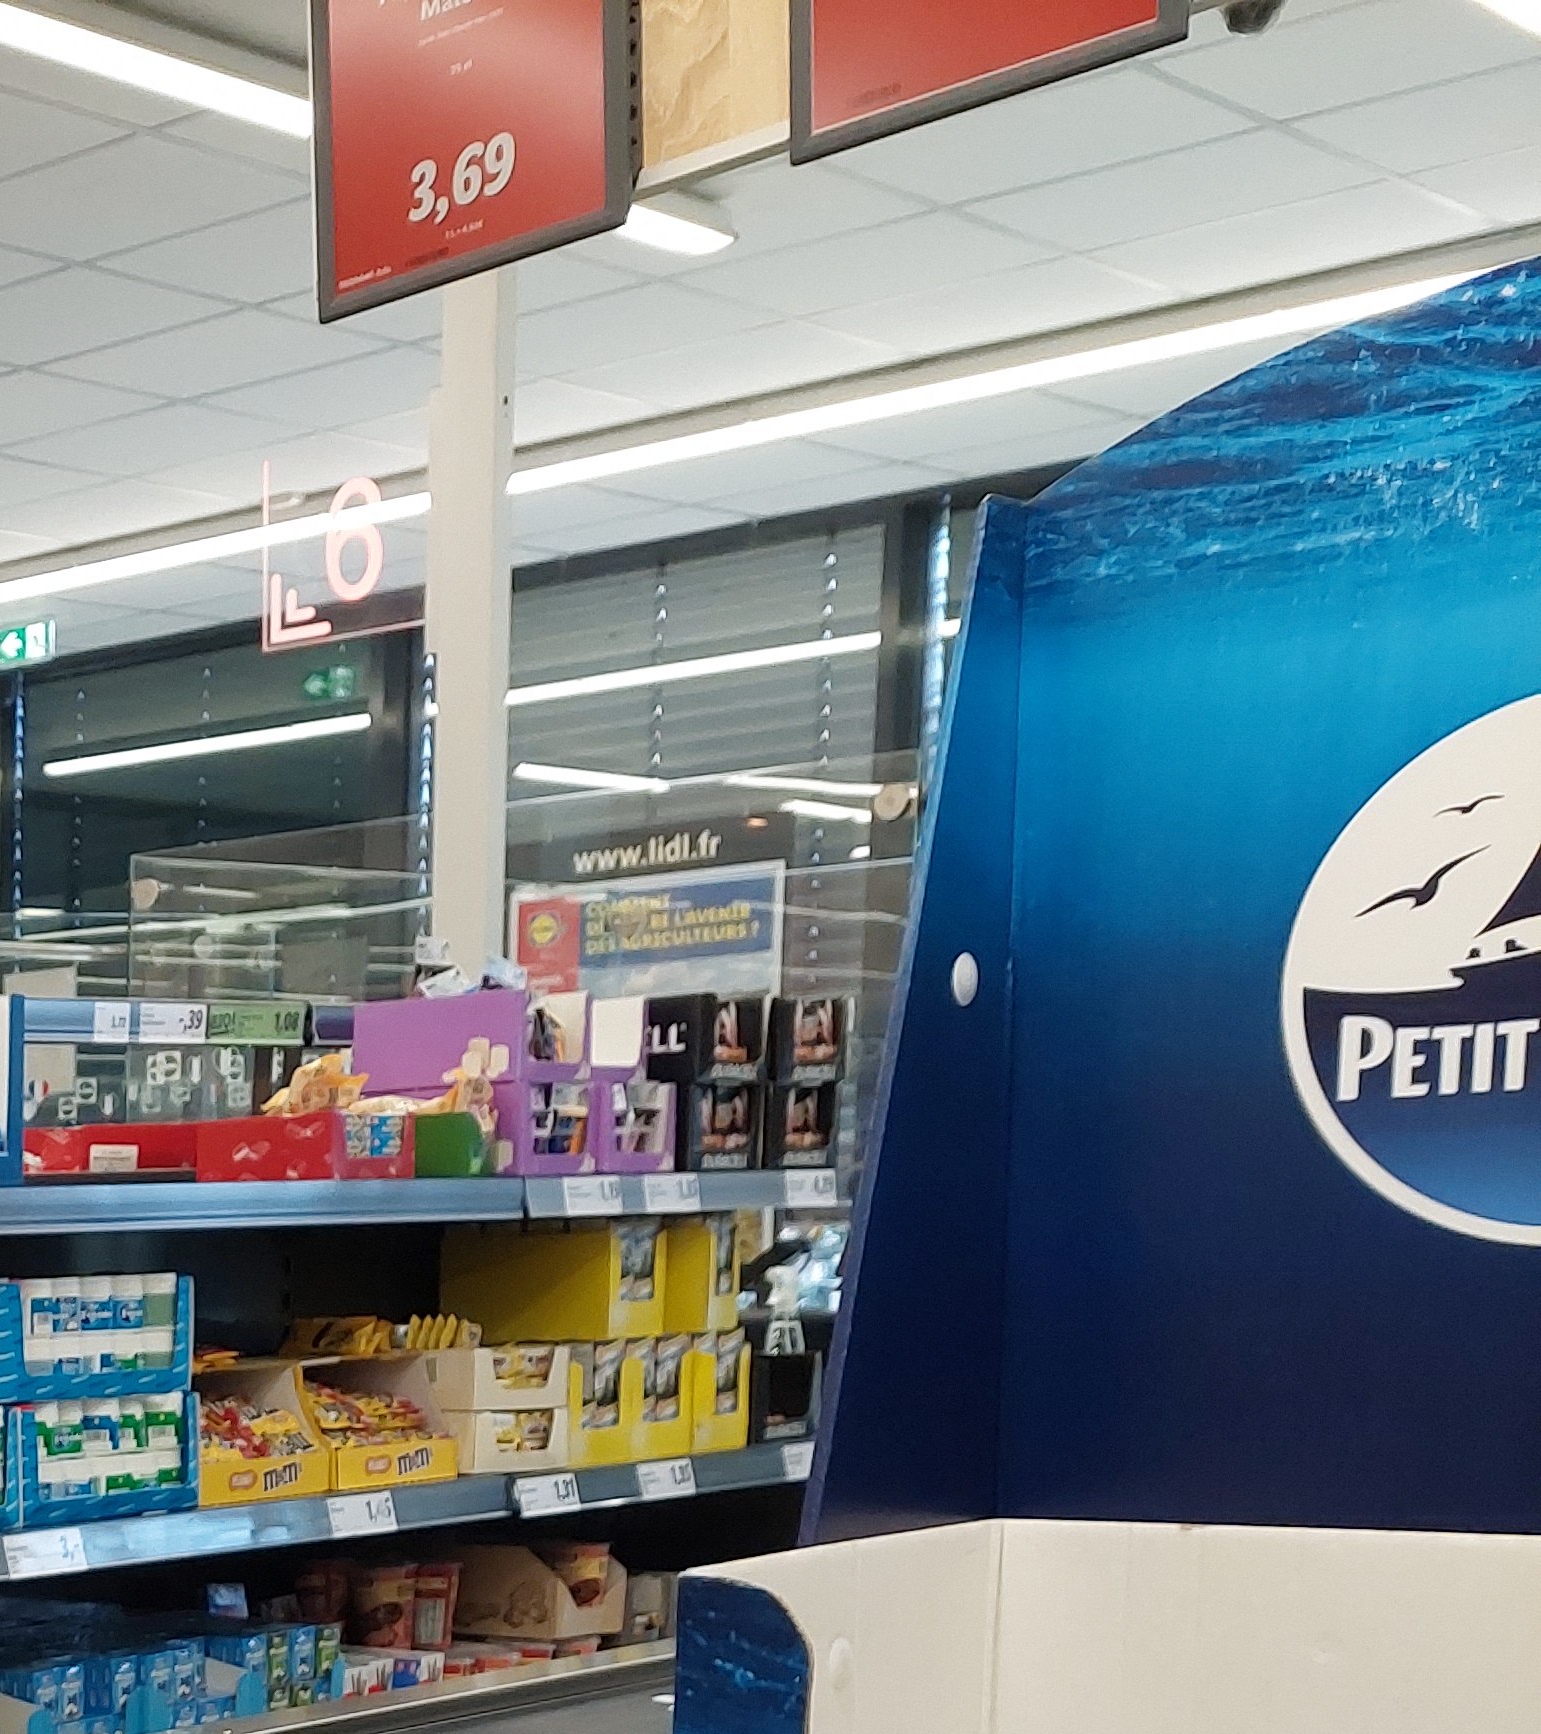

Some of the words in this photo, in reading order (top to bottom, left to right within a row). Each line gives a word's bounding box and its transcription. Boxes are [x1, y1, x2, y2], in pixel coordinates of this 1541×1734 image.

[407, 131, 516, 225] 3,69
[325, 476, 384, 602] 6
[573, 829, 722, 875] www.lidl.fr
[1337, 1012, 1541, 1102] PETIT
